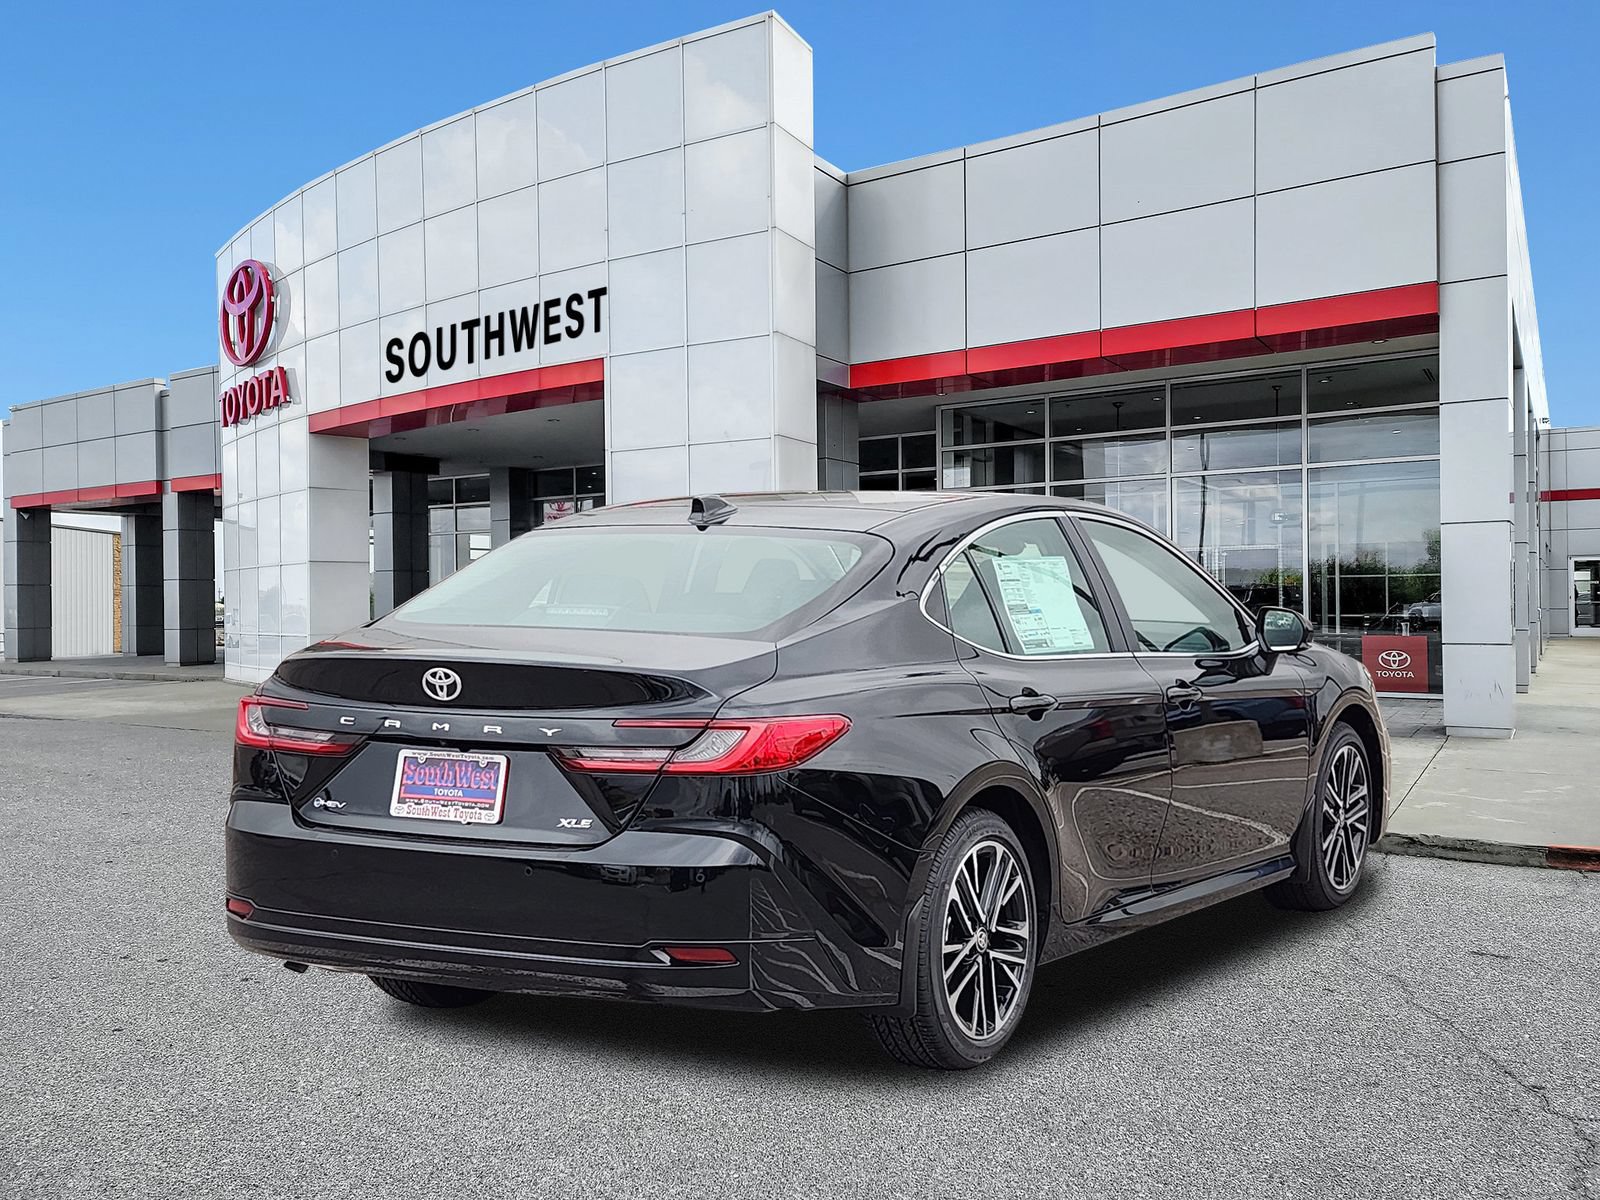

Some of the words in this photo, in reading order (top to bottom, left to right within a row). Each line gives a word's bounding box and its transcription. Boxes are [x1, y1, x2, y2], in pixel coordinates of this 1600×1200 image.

[385, 287, 608, 383] SOUTHWEST
[217, 366, 291, 427] TOYOTA
[1376, 670, 1415, 678] TOYOTA
[340, 716, 562, 737] CAMRY
[433, 787, 464, 798] TOYOTA
[453, 808, 483, 822] Toyota
[556, 818, 593, 828] XLE
